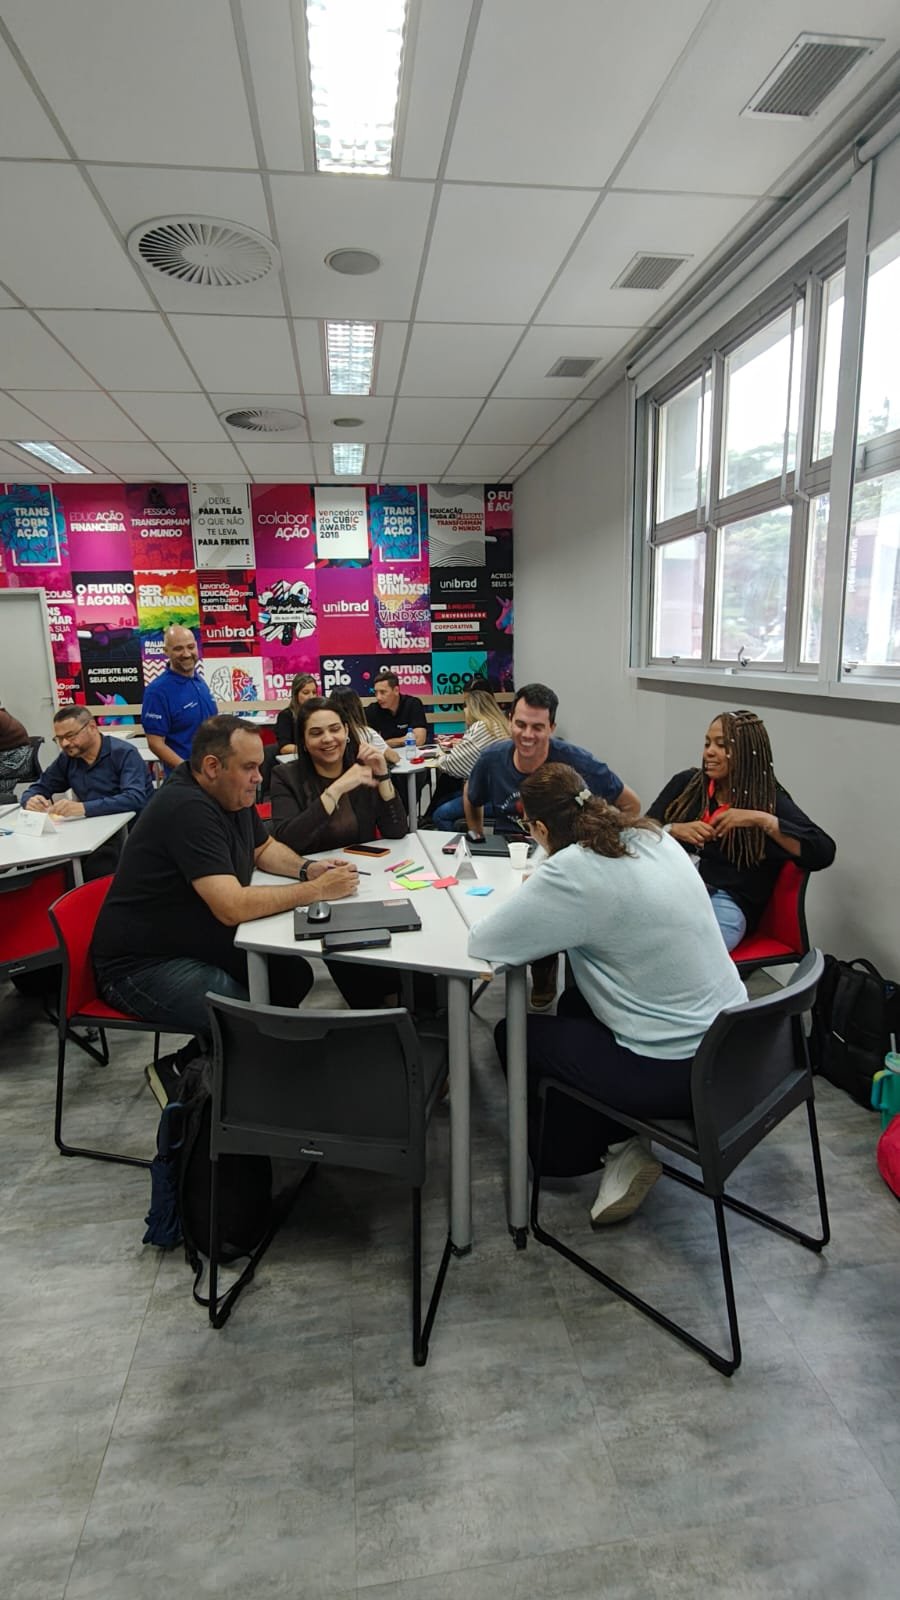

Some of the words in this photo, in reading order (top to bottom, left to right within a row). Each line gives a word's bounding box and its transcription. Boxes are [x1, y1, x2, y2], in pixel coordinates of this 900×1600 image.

[488, 491, 496, 500] O
[208, 497, 231, 505] DEIXE
[13, 507, 50, 517] TRANS
[222, 506, 242, 515] TRÁS
[318, 508, 364, 516] vencedora
[384, 506, 416, 515] TRANS
[430, 507, 462, 515] EDUCAÇÃO
[70, 510, 124, 523] EDUCAÇÃO
[198, 518, 206, 526] O
[207, 518, 224, 526] QUE
[227, 516, 244, 526] NÃO
[258, 512, 309, 524] colabor
[384, 517, 412, 525] FORM
[15, 518, 47, 526] FORM
[70, 523, 126, 532] FINANCEIRA
[275, 524, 310, 541] AÇÃO
[384, 524, 412, 537] AÇÃO
[17, 526, 48, 540] AÇÃO
[140, 529, 149, 537] O
[150, 529, 182, 537] MUNDO
[377, 574, 410, 584] BEM-
[440, 578, 477, 589] unibrad
[76, 584, 86, 593] O
[88, 584, 134, 594] FUTURO
[139, 585, 161, 596] SER
[200, 589, 240, 597] EDUCAÇÃO
[378, 584, 429, 595] VINDXS!
[77, 593, 86, 606] É
[87, 595, 129, 606] AGORA
[140, 596, 195, 608] HUMANO
[203, 604, 248, 612] EXCELÊNCIA
[323, 600, 369, 612] unibrad
[379, 611, 430, 622] VINDXS!
[206, 626, 254, 638] unibrad
[380, 628, 411, 638] BEM-
[380, 638, 429, 649] VINDXS!
[323, 660, 344, 671] ex
[390, 665, 431, 674] FUTURO
[266, 674, 284, 688] 10
[324, 671, 351, 688] plo
[398, 675, 426, 685] GORA
